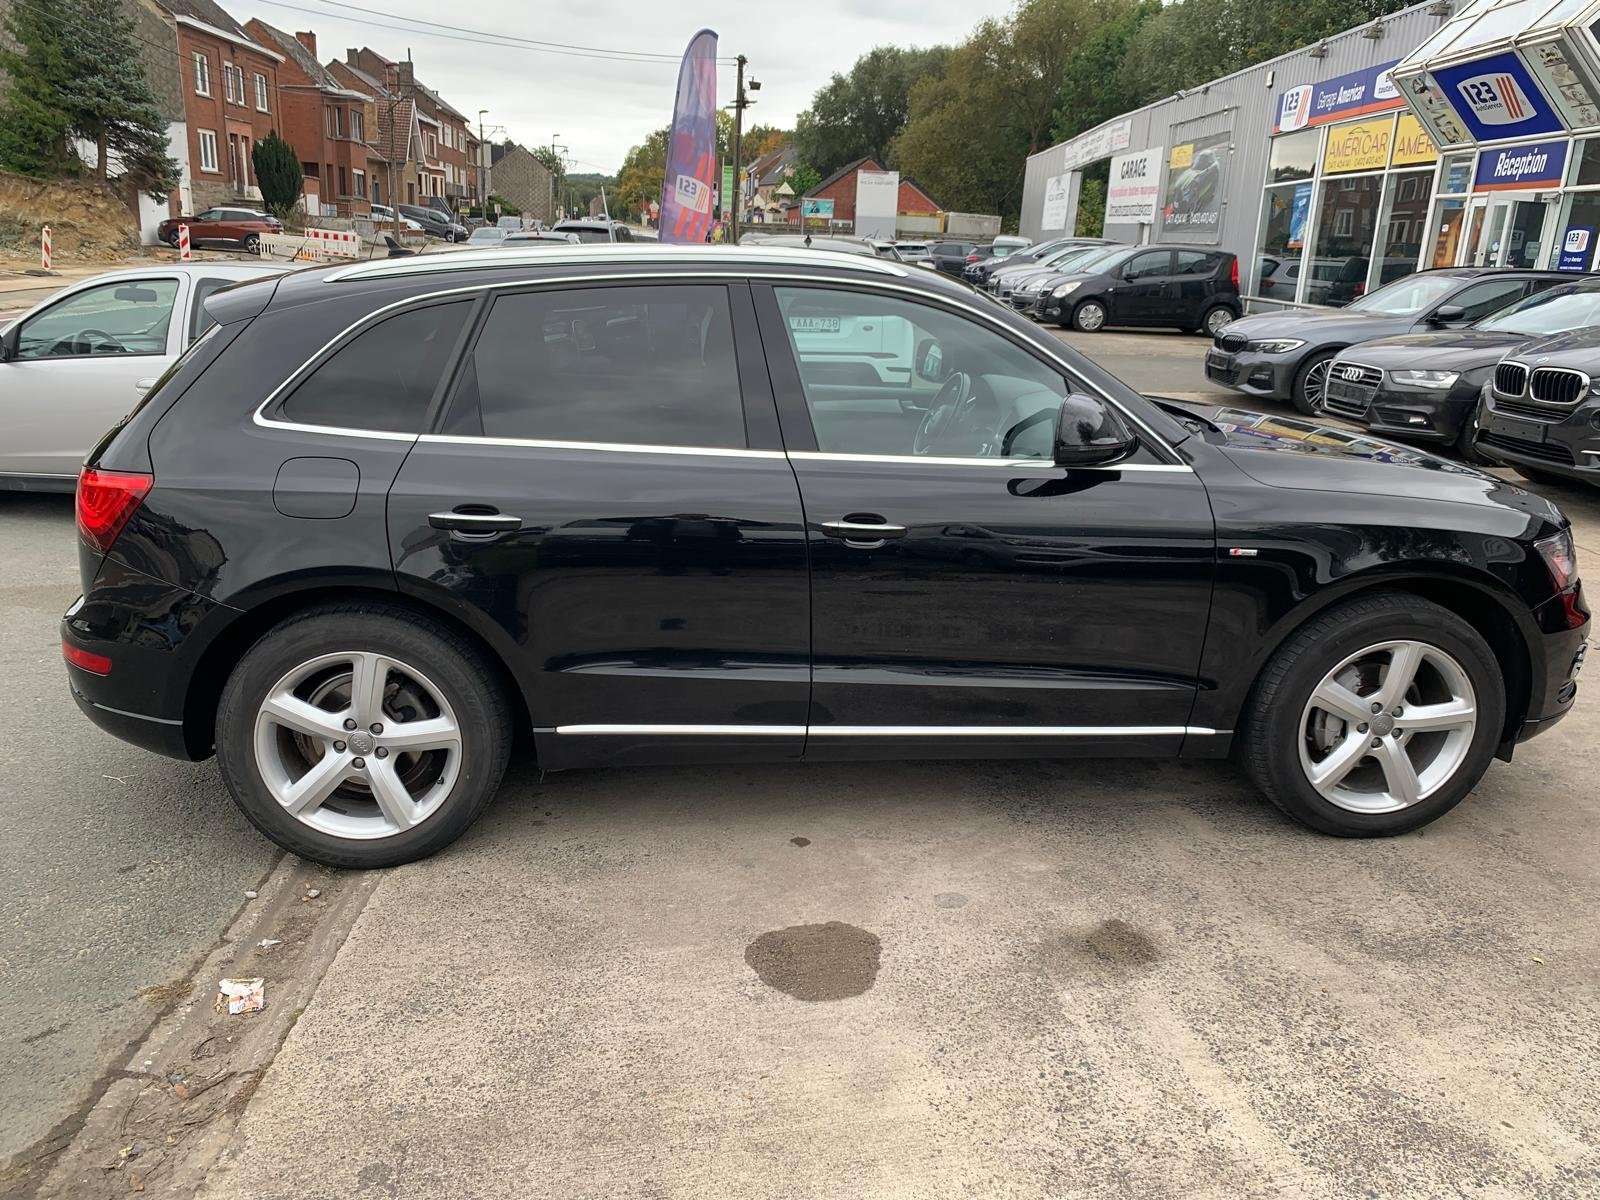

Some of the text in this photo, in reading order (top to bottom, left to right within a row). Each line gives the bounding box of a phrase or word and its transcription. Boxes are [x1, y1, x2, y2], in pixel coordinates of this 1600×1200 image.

[1284, 91, 1300, 112] 123
[1316, 83, 1365, 110] Garage Americar
[1462, 81, 1498, 105] 123
[1475, 102, 1504, 112] AutoService
[1329, 132, 1389, 158] AMERICAR
[1121, 158, 1147, 180] GARAGE
[1494, 147, 1548, 181] Réception
[678, 177, 698, 196] 123
[1568, 232, 1580, 242] 123
